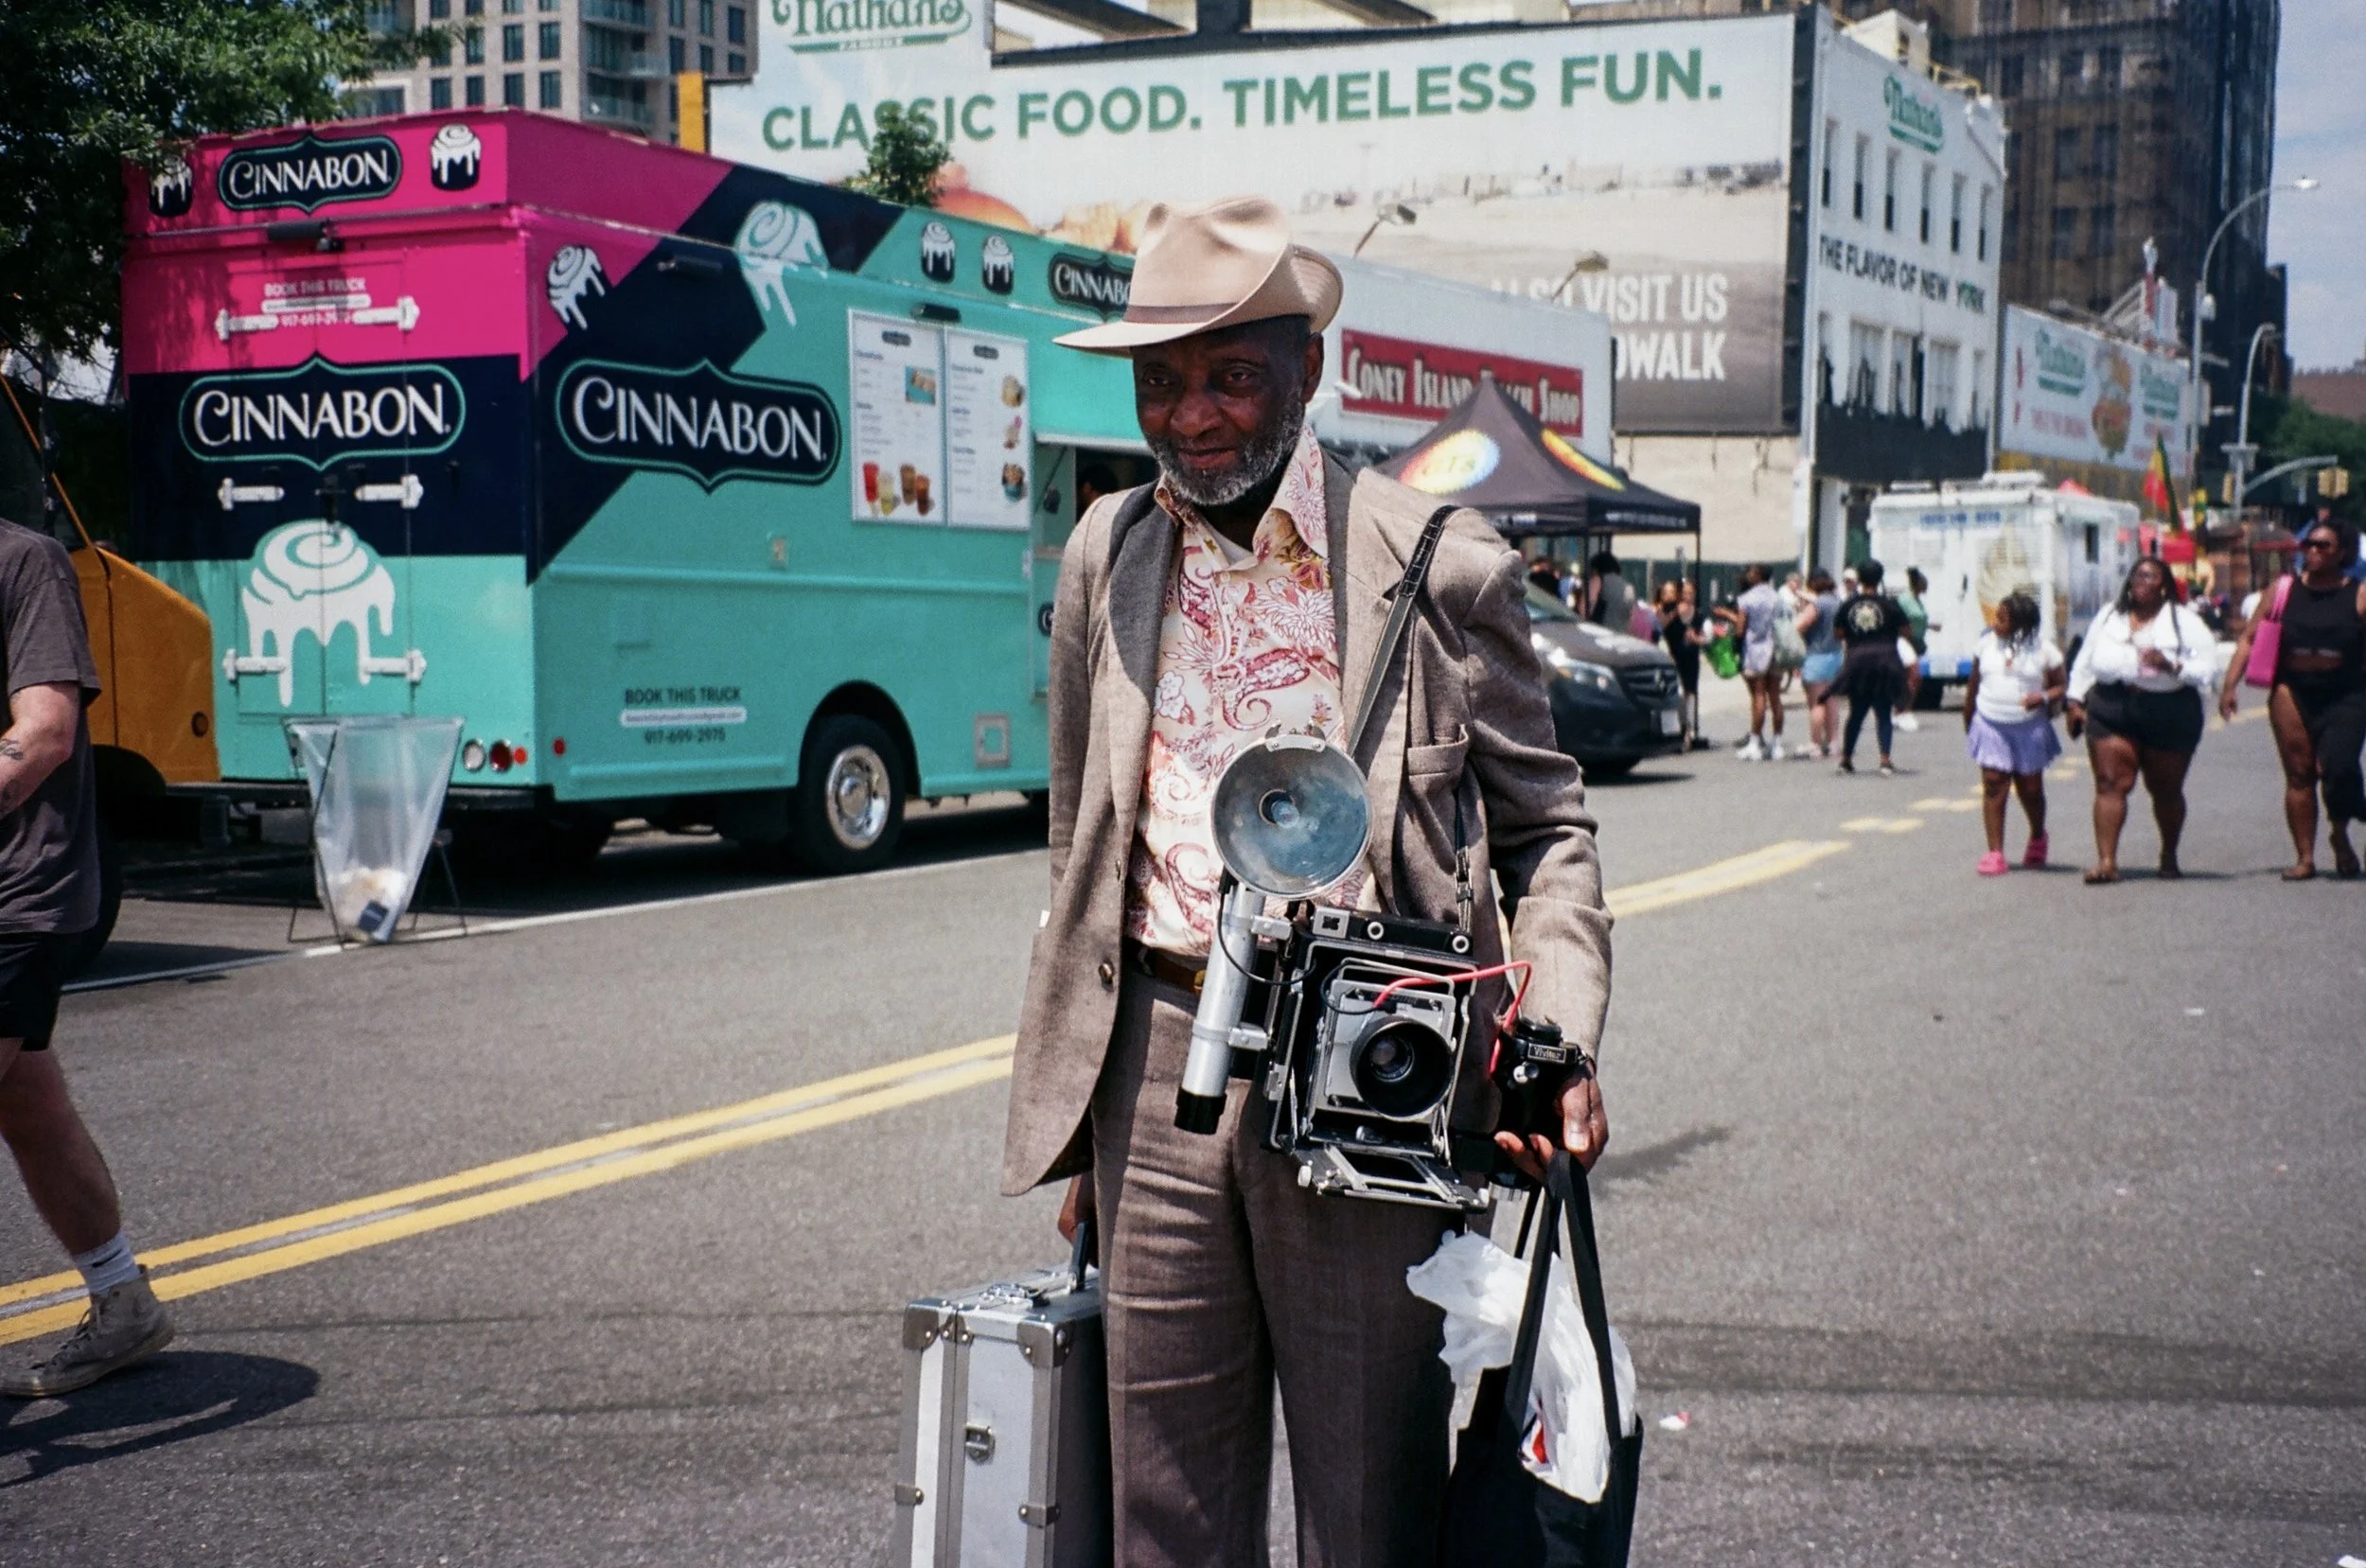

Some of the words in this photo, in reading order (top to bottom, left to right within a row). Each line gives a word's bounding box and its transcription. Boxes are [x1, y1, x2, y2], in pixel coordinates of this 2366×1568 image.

[1016, 84, 1202, 139] FOOD.
[1223, 60, 1536, 128] TIMELESS
[1561, 48, 1723, 107] FUN.
[1581, 274, 1673, 323] VISIT
[1680, 273, 1729, 323] US
[1819, 234, 1843, 273] THE
[1846, 243, 1897, 287] FLAVOR
[1899, 259, 1917, 291] OF
[1920, 268, 1949, 302] NEW
[1347, 347, 1406, 405] CONEY
[1413, 358, 1474, 409] ISLAND
[625, 687, 662, 705] BOOK
[666, 686, 697, 704] THIS
[699, 685, 742, 703] TRUCK
